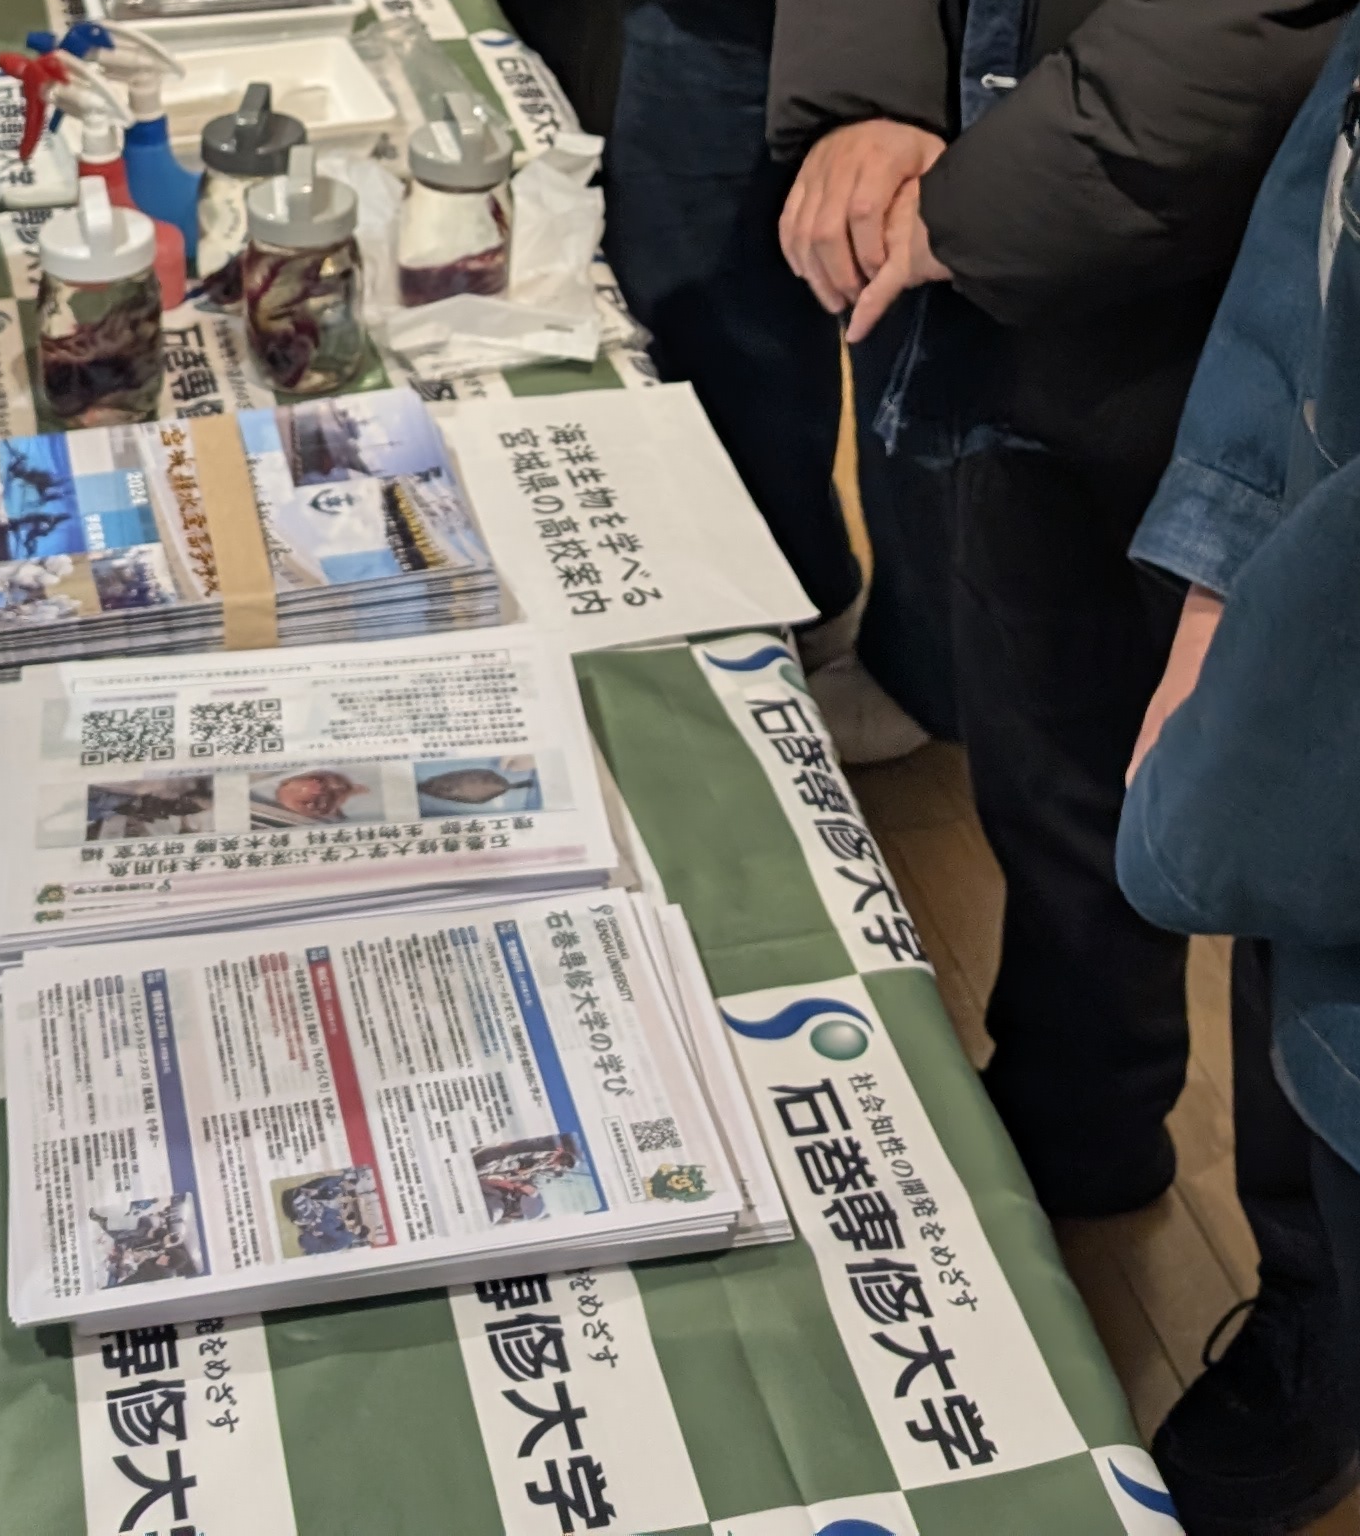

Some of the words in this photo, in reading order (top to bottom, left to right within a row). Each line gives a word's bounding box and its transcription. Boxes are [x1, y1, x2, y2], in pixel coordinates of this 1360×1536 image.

[498, 427, 612, 615] 宮城県の高校案内
[546, 423, 663, 606] 海洋生物を学べる
[744, 696, 929, 962] 石巻専修大学
[546, 911, 634, 1097] 石巻専修大学の学び
[606, 952, 634, 1002] UNIVERSITY
[767, 1078, 998, 1470] 石巻専修大学
[848, 1072, 978, 1312] 社会知性の開発をめざす
[568, 1267, 619, 1368] をめざす
[99, 1322, 198, 1536] 専修大
